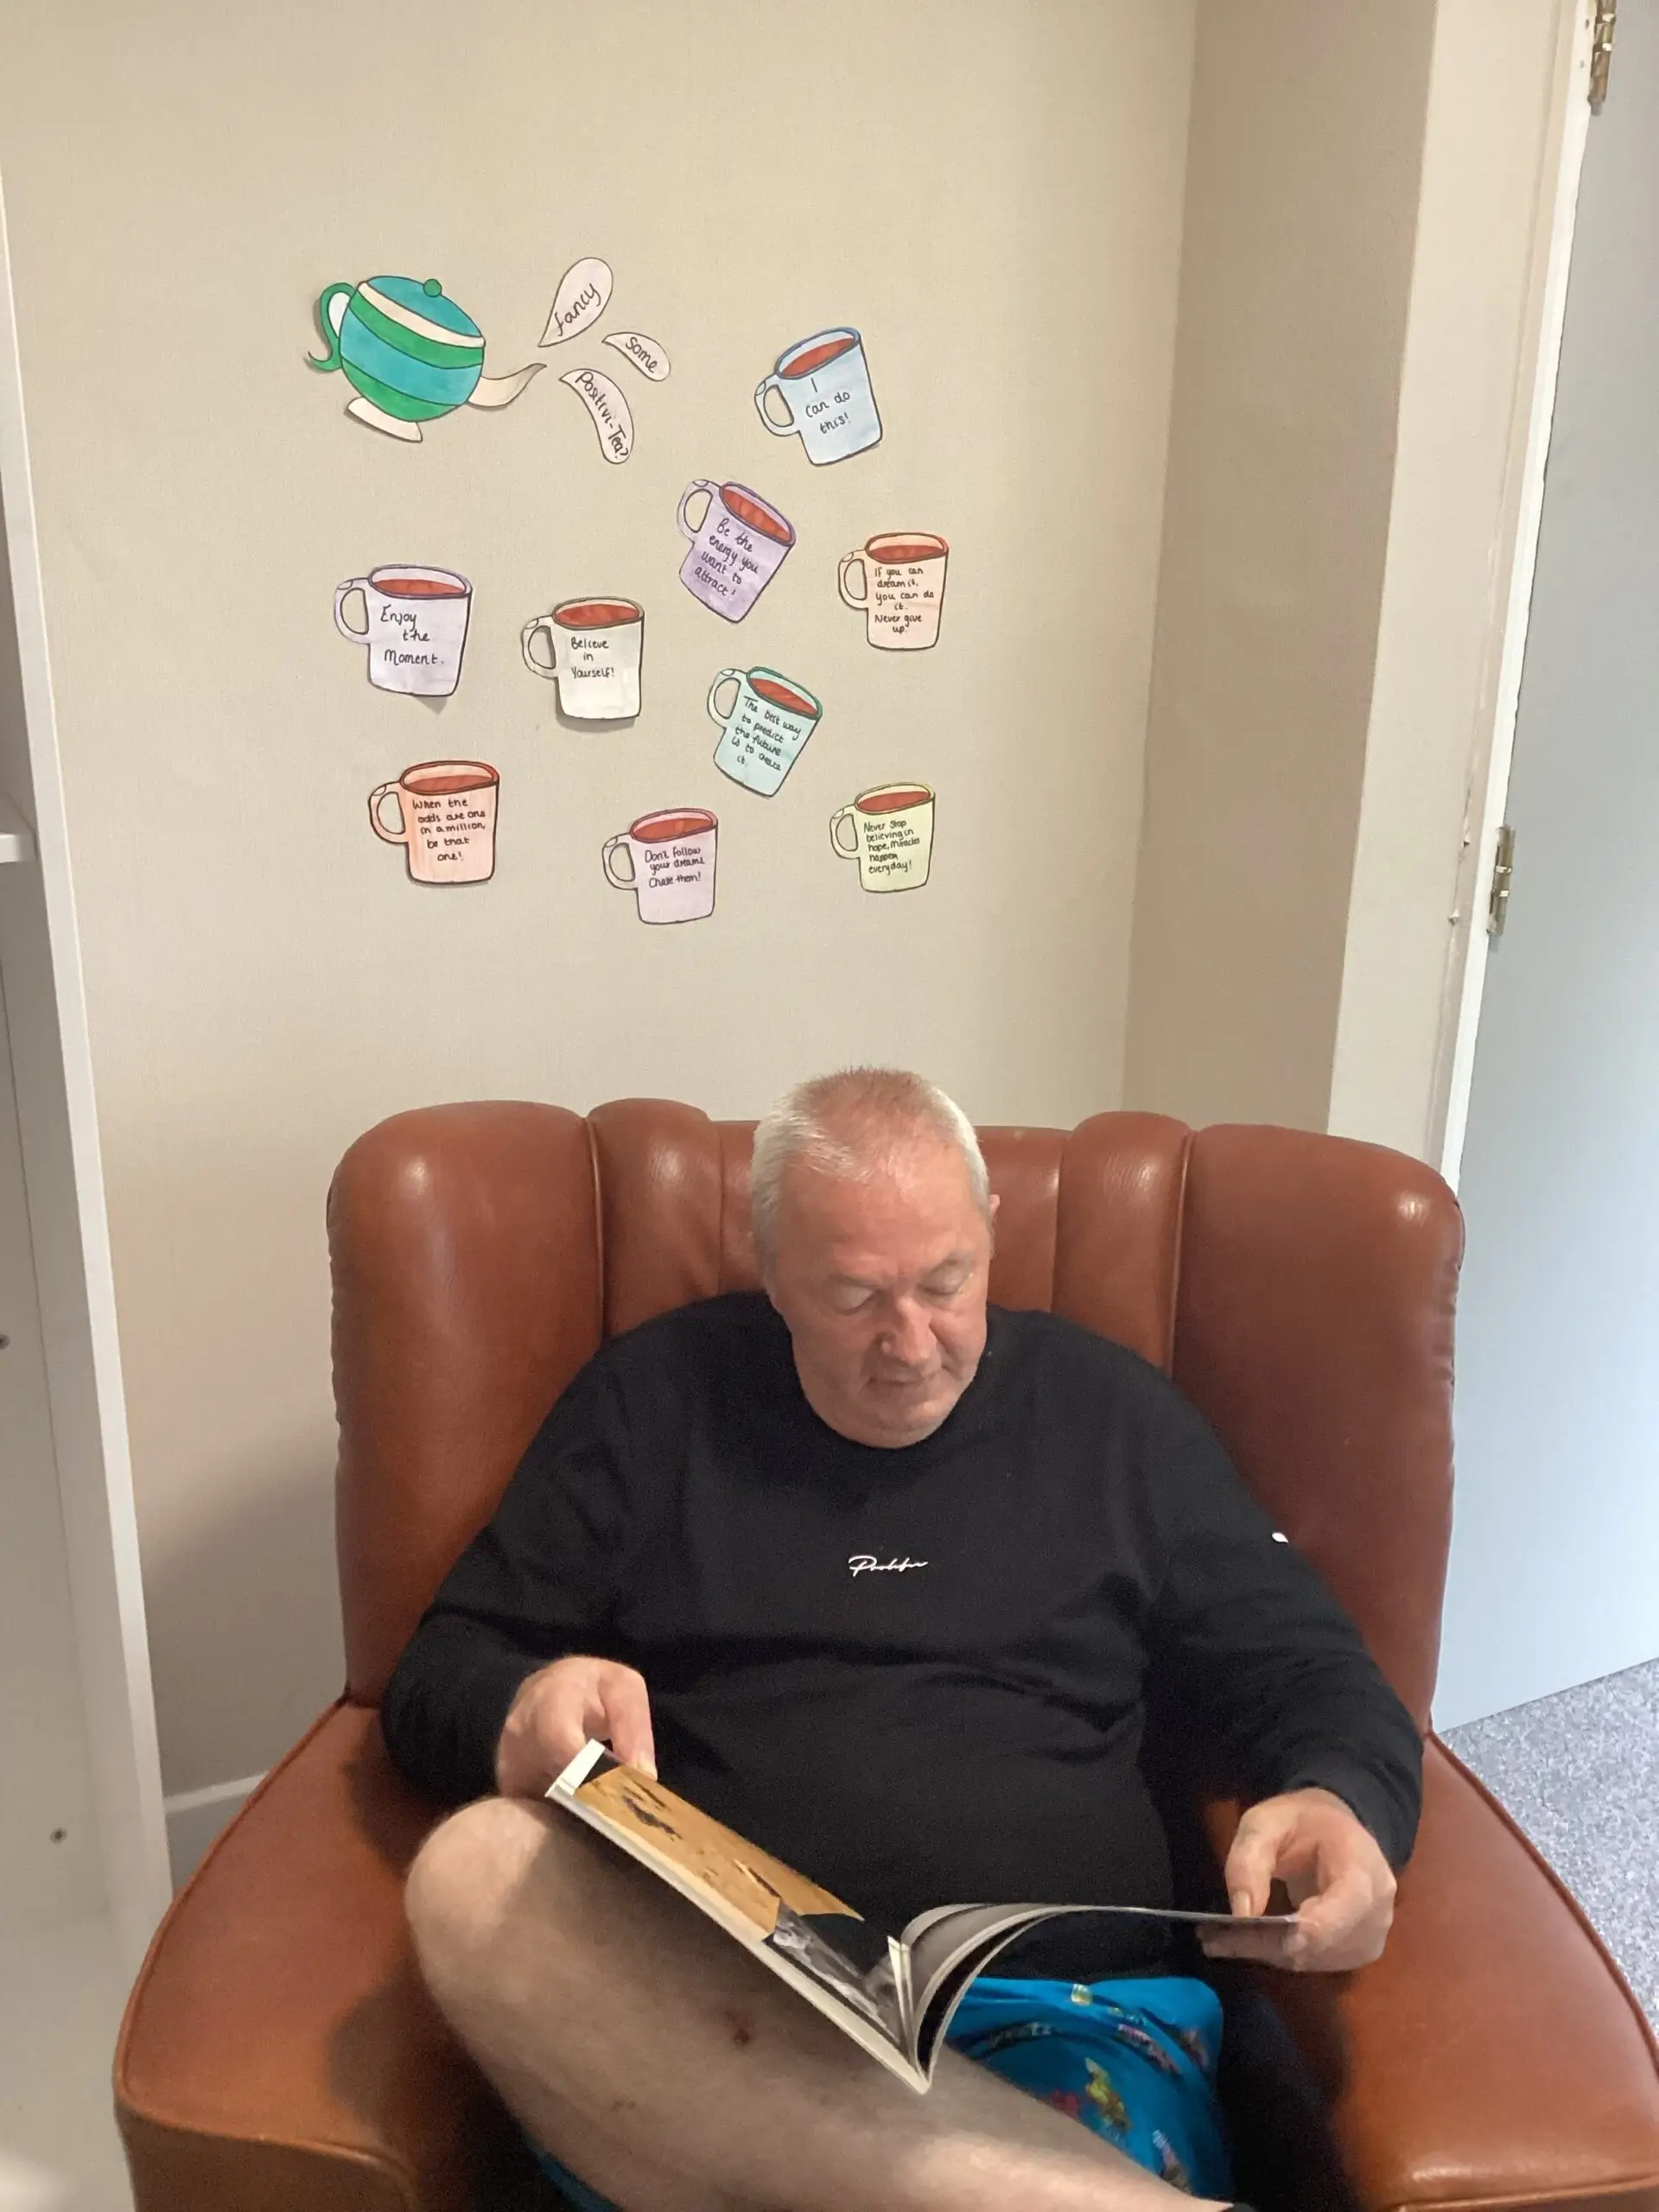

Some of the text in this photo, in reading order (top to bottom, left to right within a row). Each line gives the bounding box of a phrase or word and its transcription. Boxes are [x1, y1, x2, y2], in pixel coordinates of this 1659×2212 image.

[554, 283, 601, 336] fancy
[810, 377, 817, 392] I
[834, 391, 850, 404] do
[820, 411, 851, 434] this!
[716, 518, 753, 552] Be the
[709, 535, 759, 574] energy you
[701, 551, 742, 584] want to
[874, 567, 882, 577] If
[887, 569, 902, 580] you
[875, 592, 896, 606] you
[380, 603, 416, 632] Enjoy
[874, 614, 922, 627] Never give
[403, 628, 430, 641] the
[570, 636, 609, 650] Believe
[583, 652, 594, 662] in
[743, 696, 802, 741] The best way
[741, 713, 785, 743] to predict
[734, 726, 782, 756] the future
[731, 736, 781, 771] is to create
[412, 798, 468, 810] When the
[417, 813, 441, 823] odds
[446, 812, 465, 821] are
[864, 821, 886, 833] Never
[427, 836, 470, 849] be that
[866, 830, 904, 842] believing
[437, 852, 463, 861] one!
[645, 847, 701, 863] Don't follow
[868, 853, 899, 862] happen
[650, 856, 705, 876] your dreams
[649, 871, 701, 888] Chase them!
